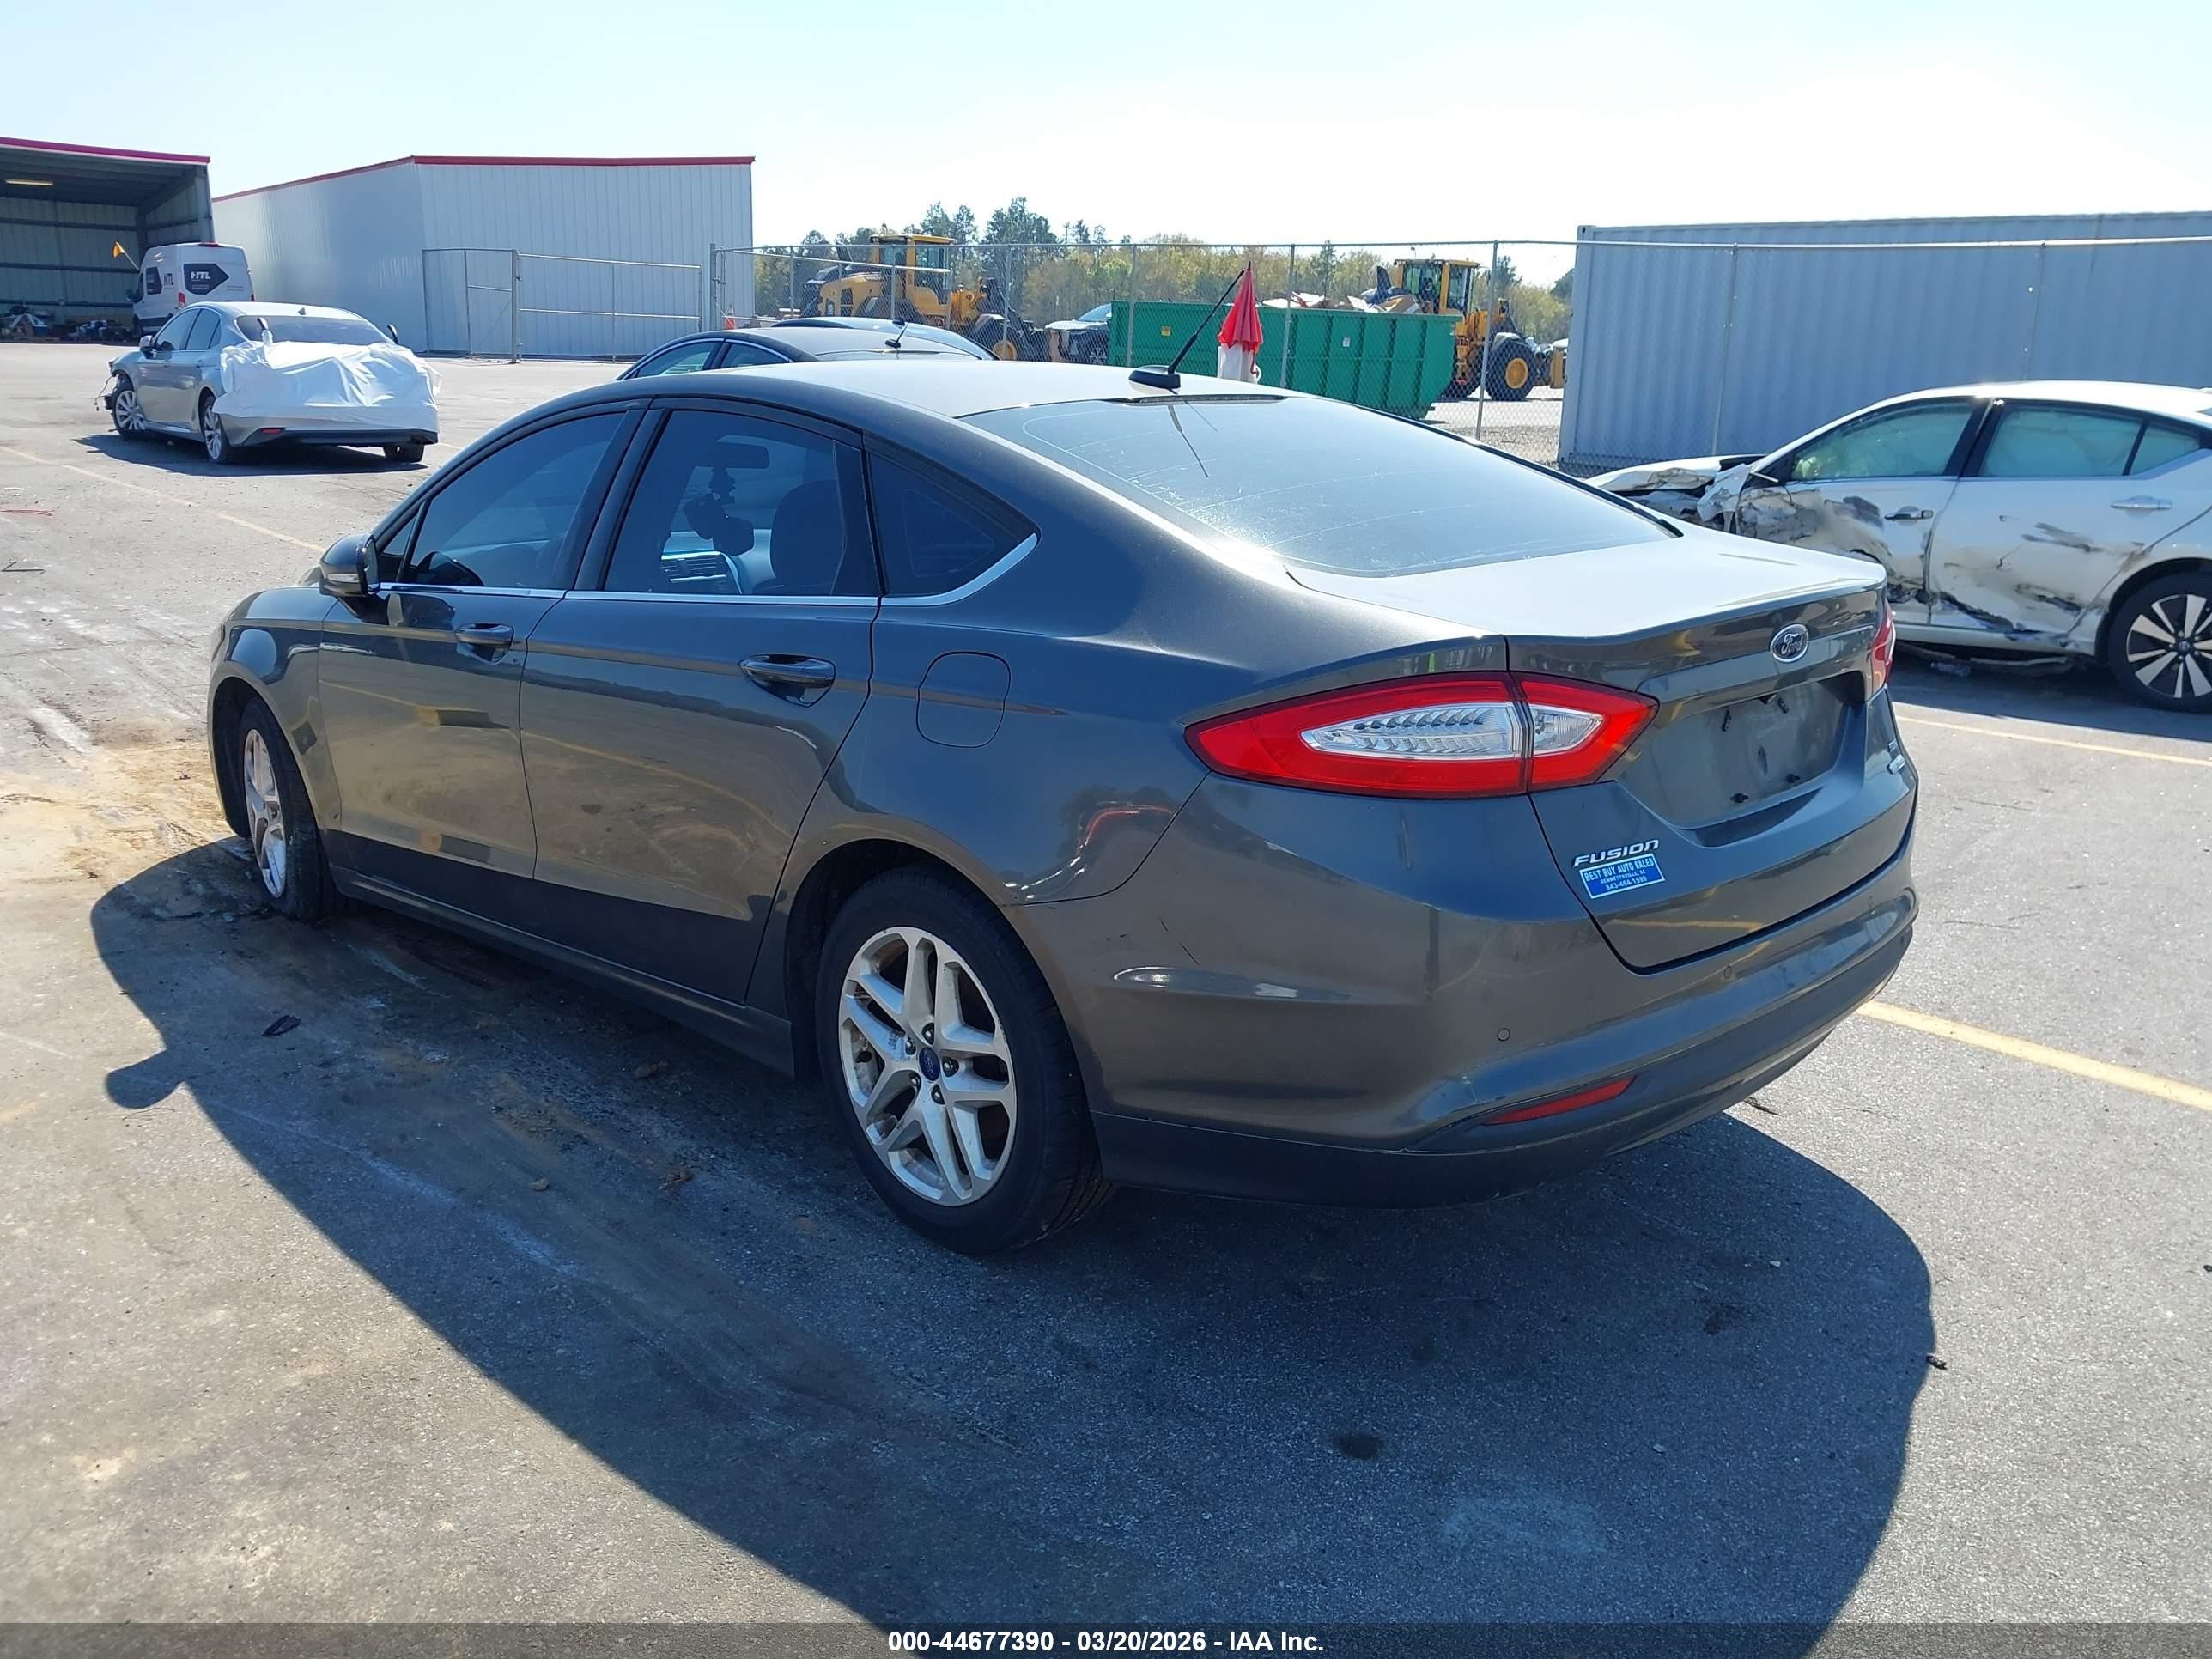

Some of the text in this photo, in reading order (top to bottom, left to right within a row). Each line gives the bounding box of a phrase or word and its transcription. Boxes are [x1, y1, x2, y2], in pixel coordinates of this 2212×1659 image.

[1781, 632, 1803, 655] Ford
[1572, 839, 1660, 868] FUSION
[1583, 857, 1655, 882] BEST BUY AUTO SALES
